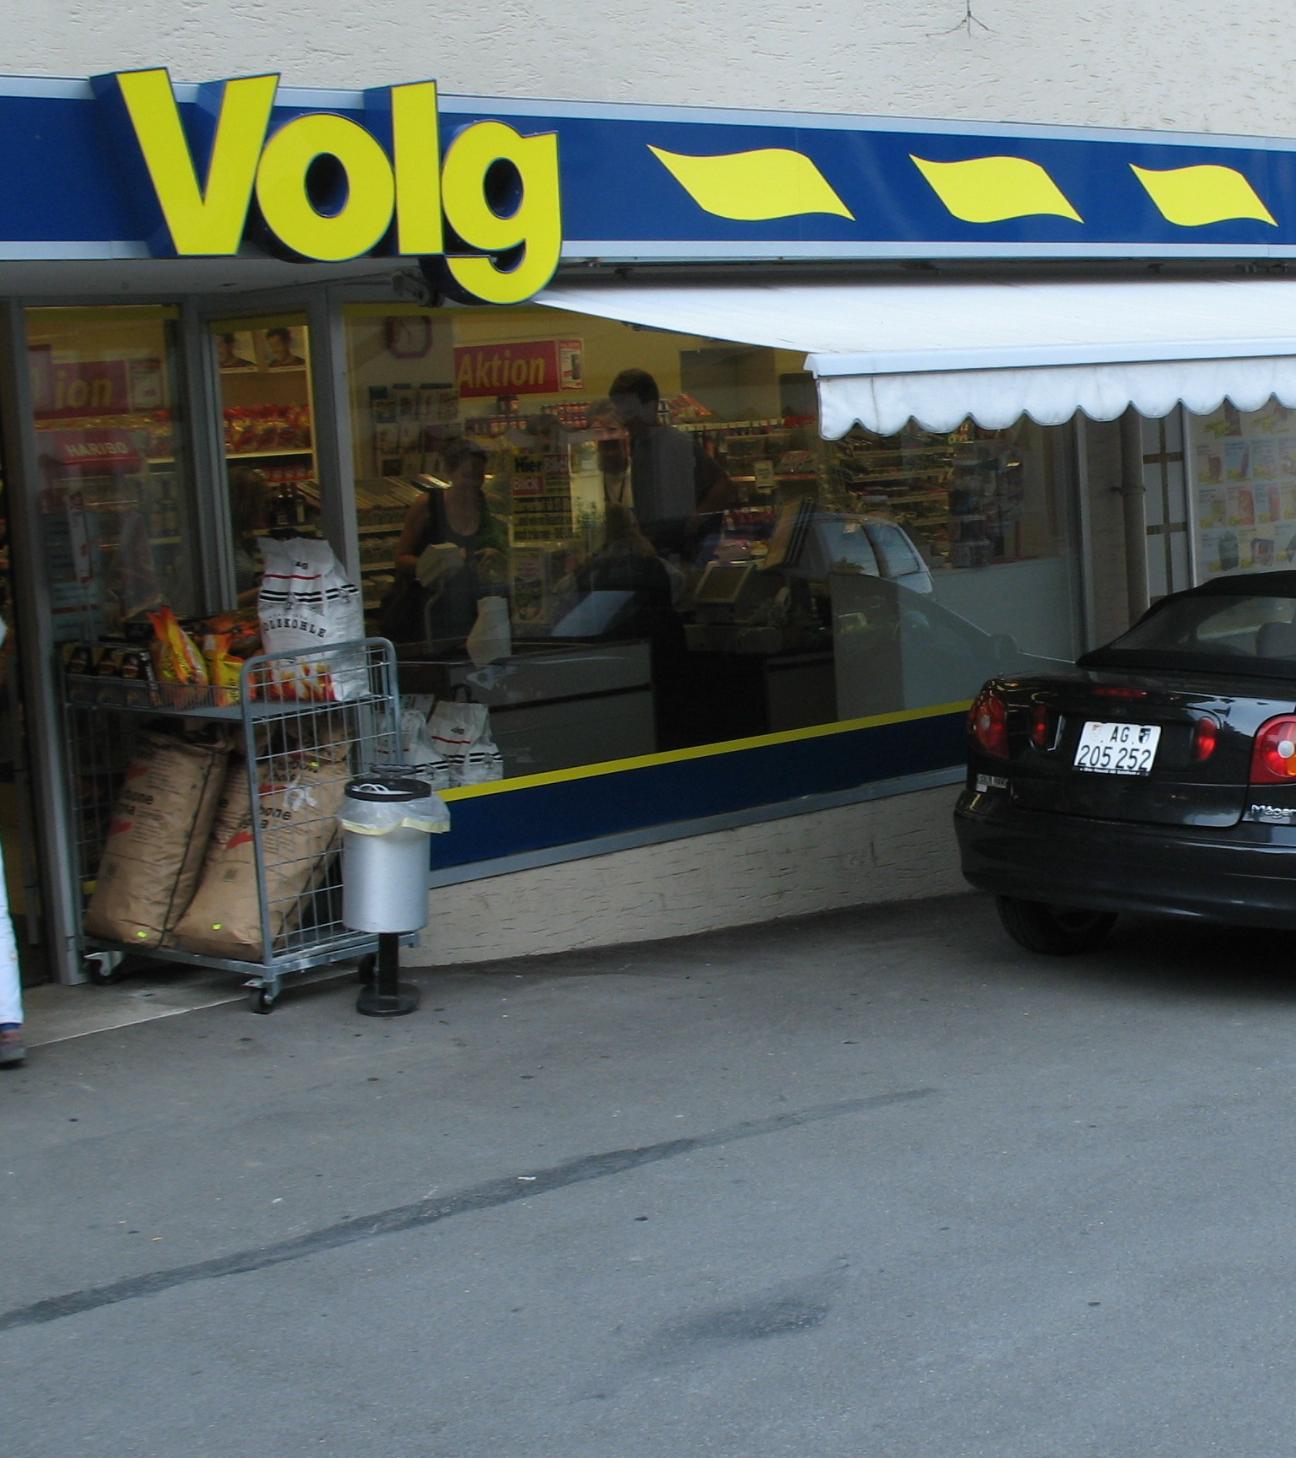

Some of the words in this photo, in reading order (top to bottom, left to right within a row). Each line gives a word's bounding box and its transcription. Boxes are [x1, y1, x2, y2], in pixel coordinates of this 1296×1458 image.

[100, 67, 563, 304] Volg
[458, 351, 546, 389] Aktion
[65, 442, 129, 457] HARIBO
[1110, 726, 1130, 744] AG
[1078, 745, 1111, 767] 205
[1115, 748, 1152, 771] 252
